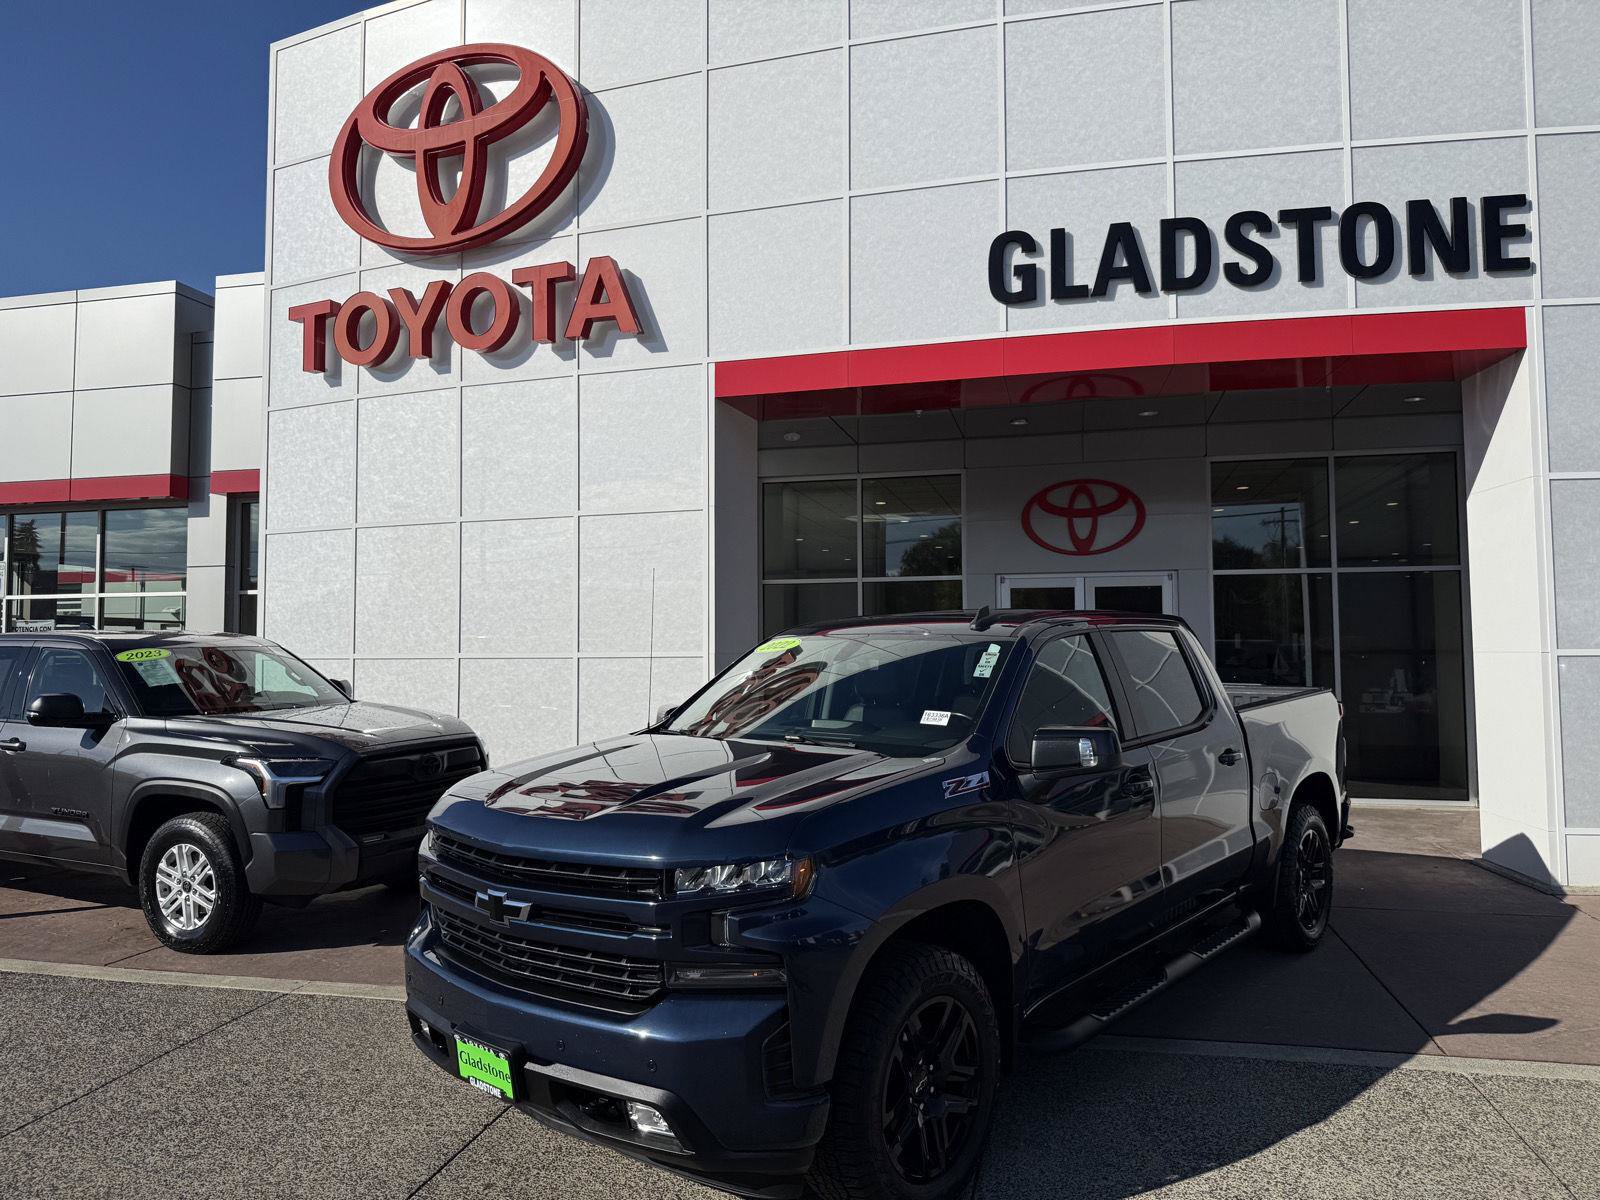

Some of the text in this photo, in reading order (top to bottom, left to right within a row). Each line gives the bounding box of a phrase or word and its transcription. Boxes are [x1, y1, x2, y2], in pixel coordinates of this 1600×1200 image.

[988, 194, 1533, 303] GLADSTONE
[288, 255, 644, 373] TOYOTA
[126, 650, 162, 661] 2023
[459, 1050, 511, 1084] Gladstone
